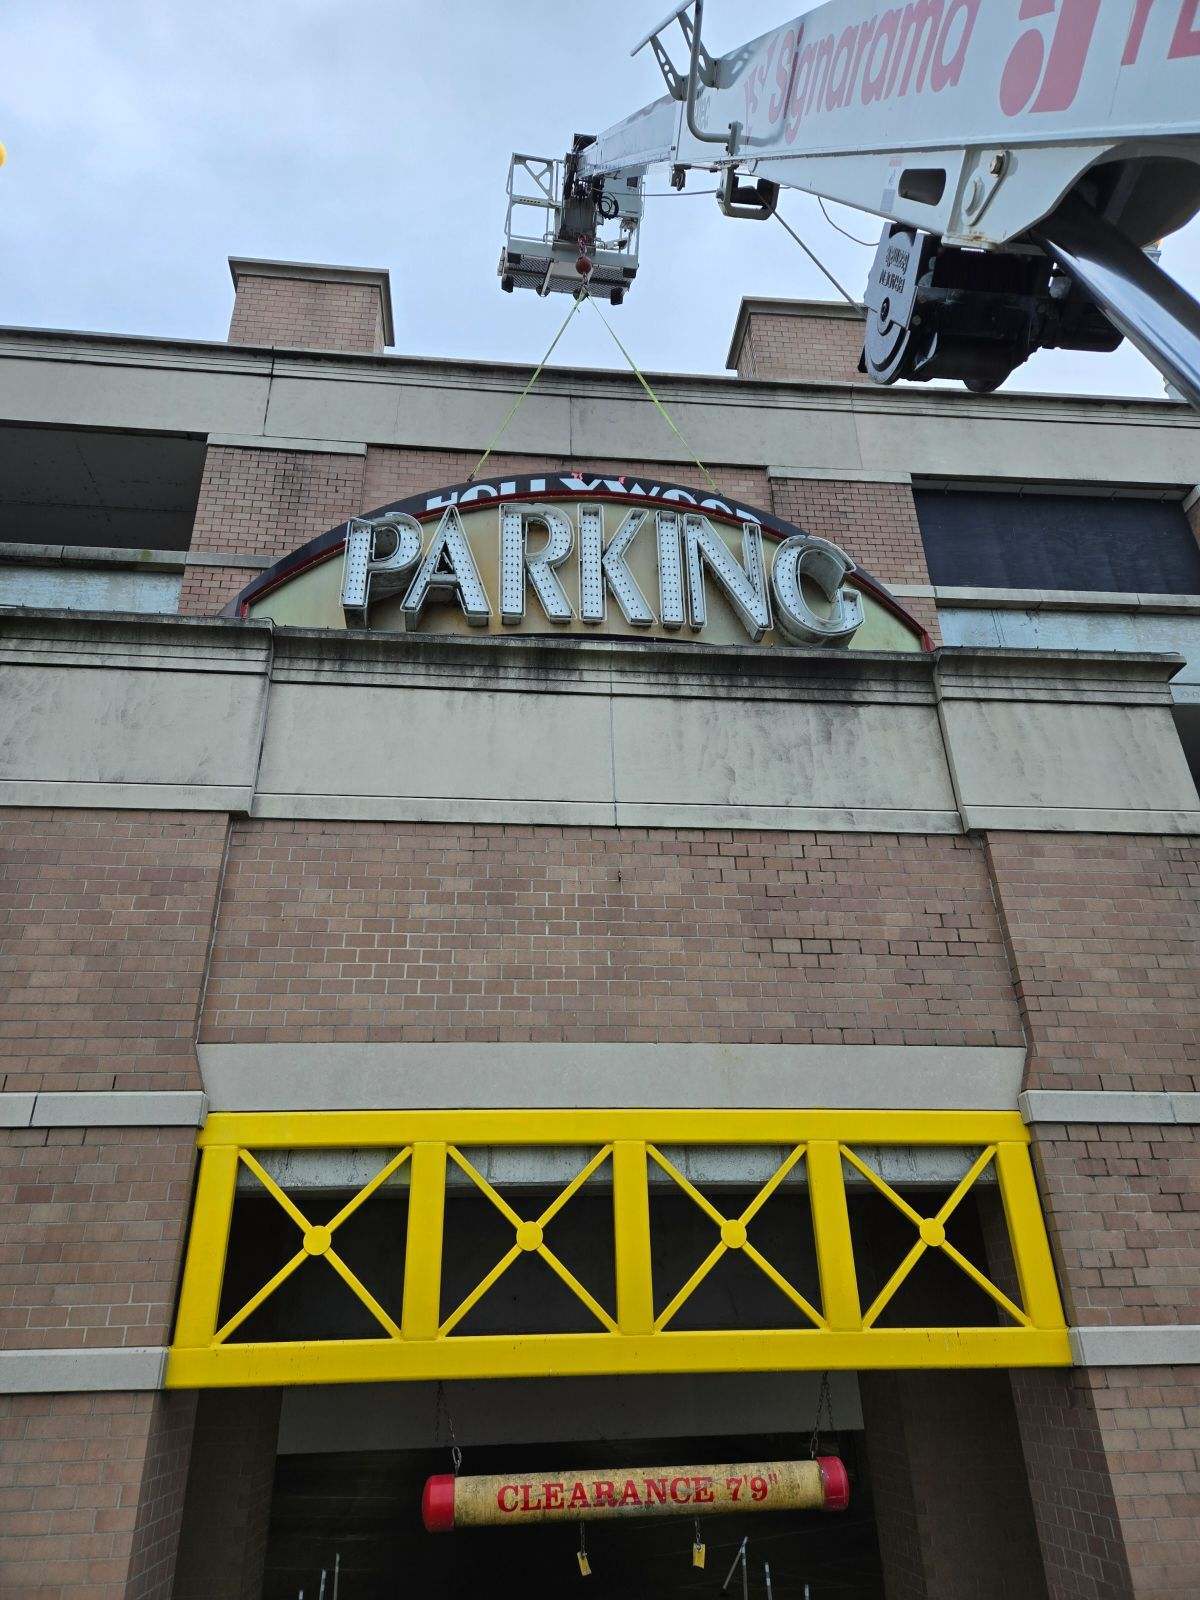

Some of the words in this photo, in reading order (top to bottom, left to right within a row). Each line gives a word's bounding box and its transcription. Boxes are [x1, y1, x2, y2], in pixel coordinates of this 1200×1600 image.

[340, 502, 866, 648] PARKING
[496, 1476, 715, 1513] CLEARANCE
[726, 1473, 779, 1505] 7'9"
